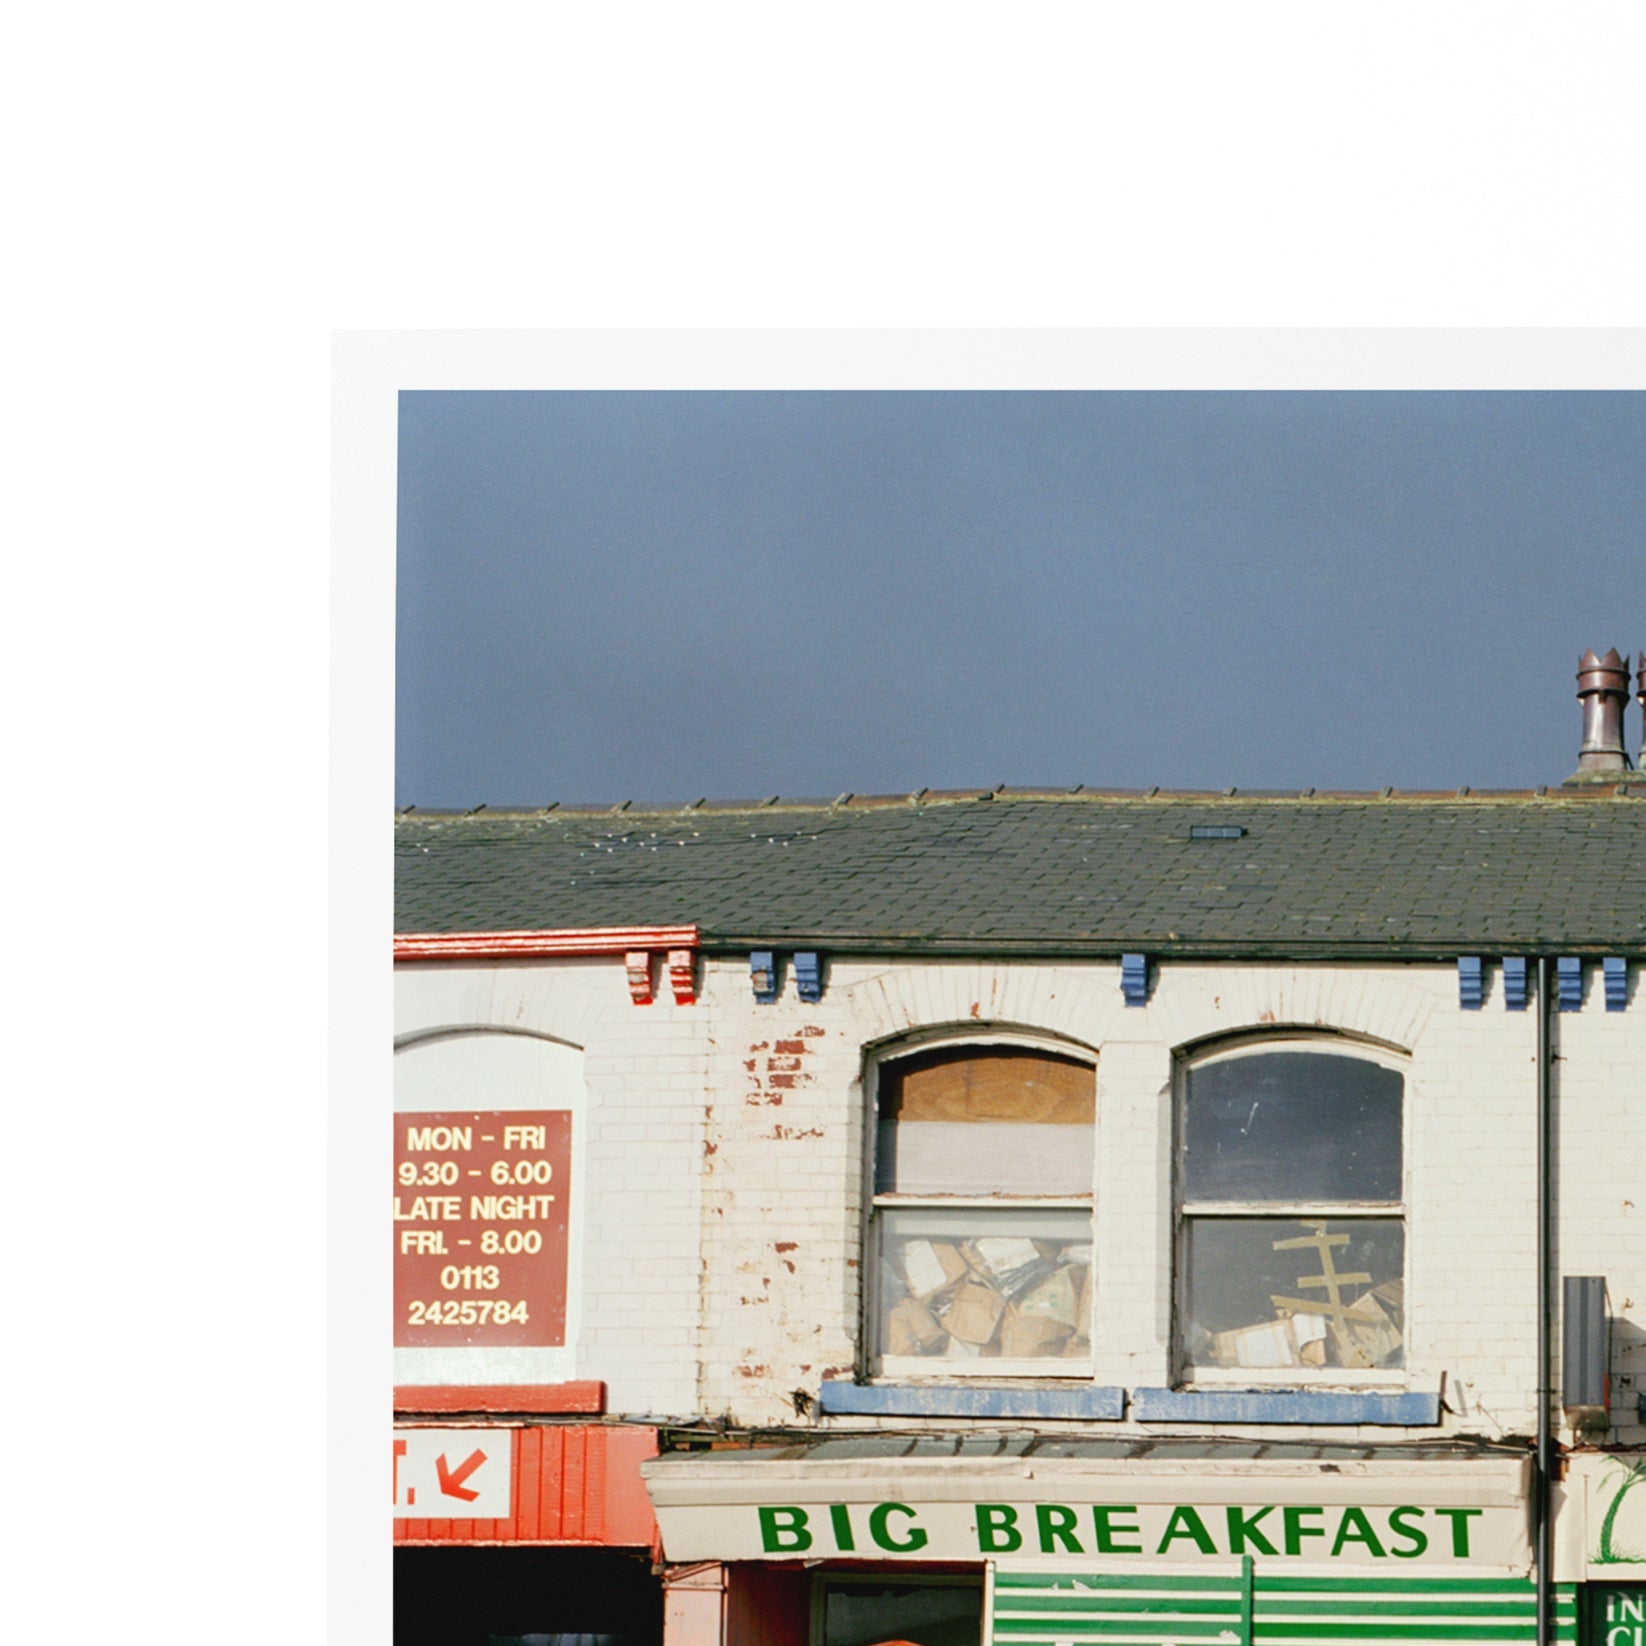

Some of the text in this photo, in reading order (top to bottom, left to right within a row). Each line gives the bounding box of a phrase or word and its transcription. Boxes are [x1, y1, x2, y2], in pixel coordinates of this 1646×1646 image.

[407, 1127, 472, 1150] MON
[504, 1126, 546, 1149] FRI
[399, 1162, 459, 1186] 9.30
[490, 1161, 552, 1185] 6.00
[394, 1196, 554, 1220] LATE NIGHT
[480, 1230, 542, 1254] 8.00
[441, 1266, 500, 1289] 0113
[408, 1301, 529, 1324] 2425784
[758, 1502, 1483, 1559] BIG BREAKFAST
